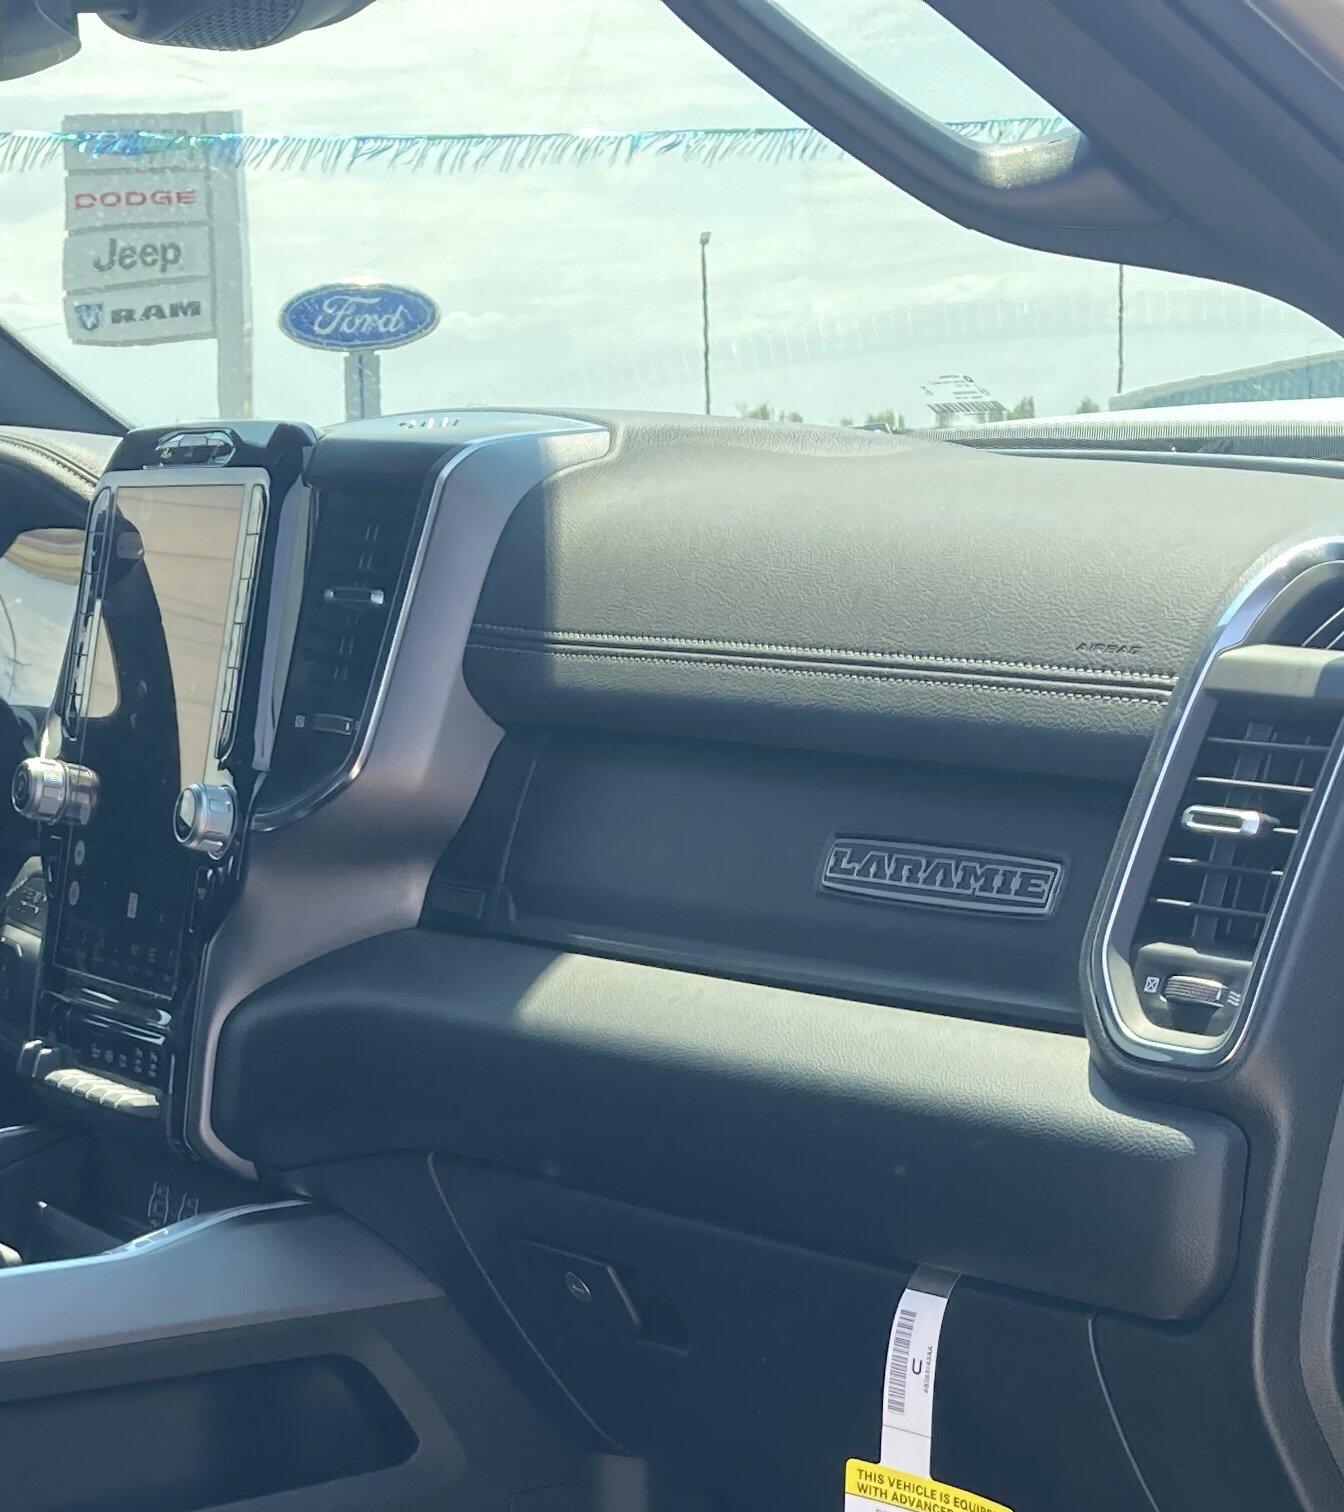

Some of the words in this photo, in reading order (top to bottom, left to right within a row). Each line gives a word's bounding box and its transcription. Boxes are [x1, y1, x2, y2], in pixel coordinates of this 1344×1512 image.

[73, 190, 197, 209] DODGE
[93, 237, 182, 273] Jeep
[110, 299, 201, 326] RAM
[314, 294, 405, 336] Ford
[825, 847, 1055, 904] LARAMIE
[857, 1468, 885, 1485] THIS
[888, 1476, 937, 1500] VEHICLE
[940, 1491, 950, 1504] IS
[857, 1482, 888, 1500] WITH
